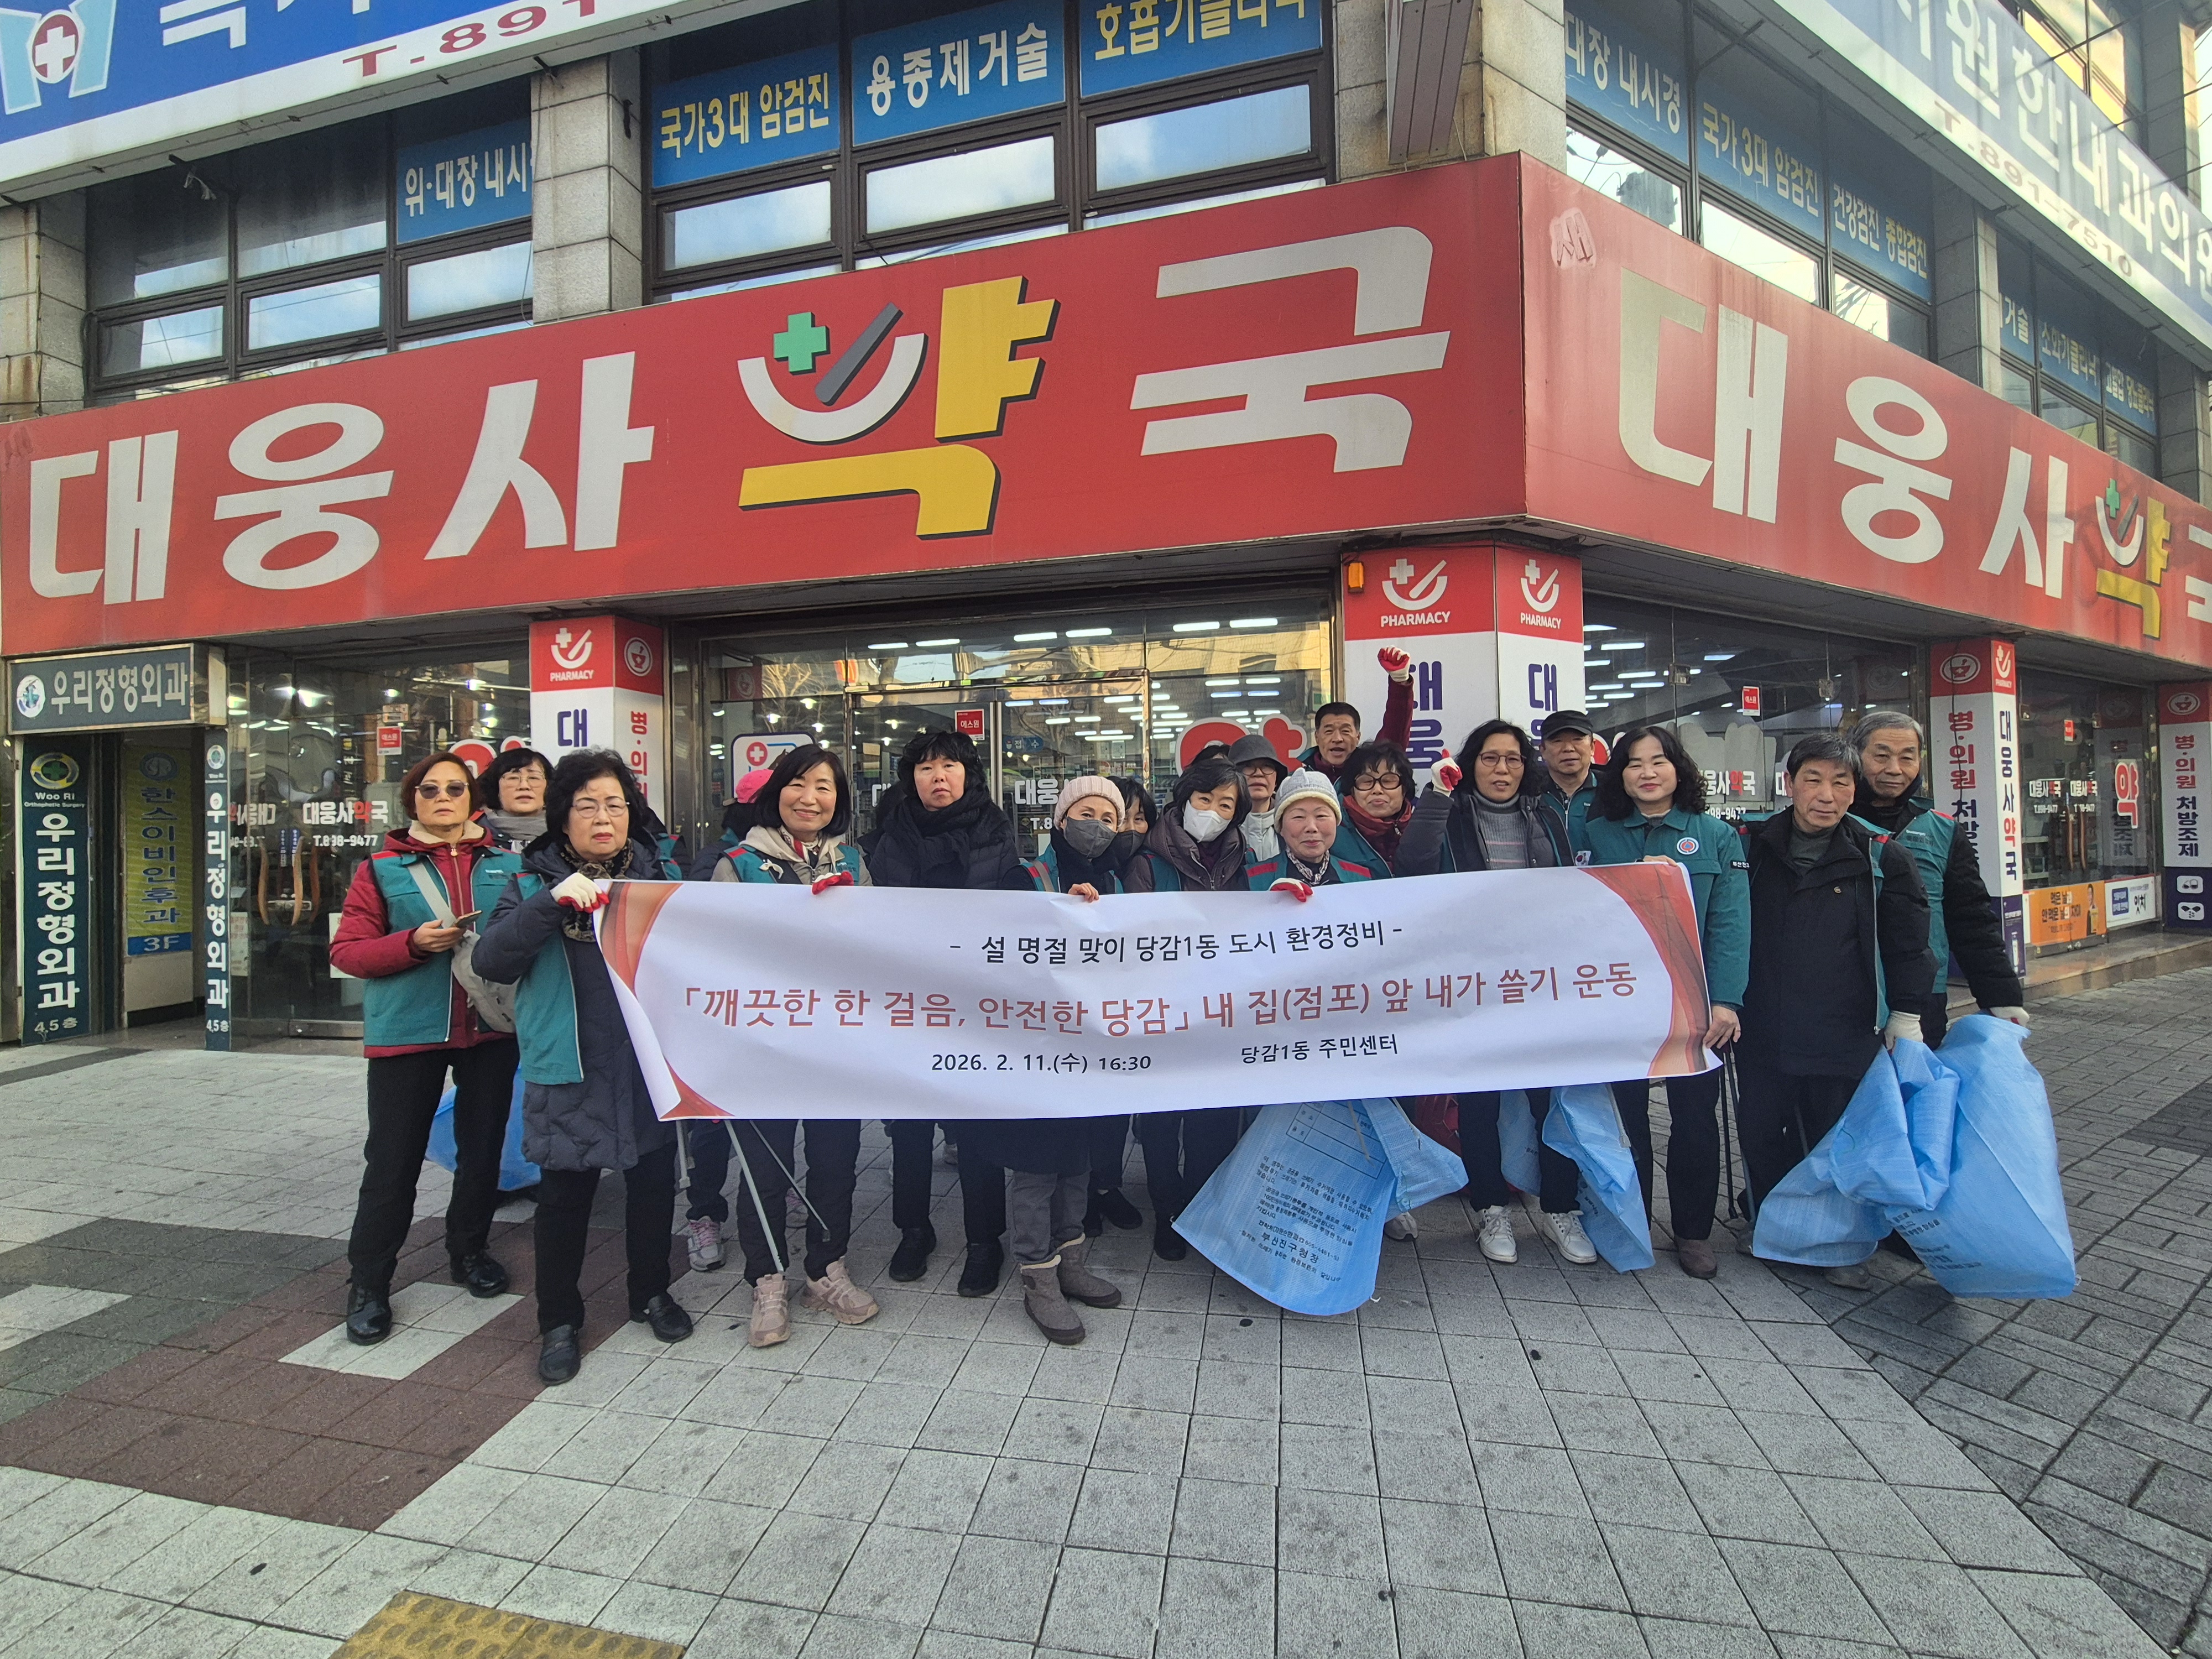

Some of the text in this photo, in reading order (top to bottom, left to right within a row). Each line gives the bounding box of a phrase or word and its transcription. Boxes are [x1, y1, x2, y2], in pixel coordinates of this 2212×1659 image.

[867, 23, 1047, 116] 용종제거술
[1564, 14, 1680, 134] 대장 내시경
[661, 72, 829, 158] 국가3대 암검진
[405, 143, 531, 217] 위·대장 내시
[1703, 102, 1818, 217] 국가3대 암검진
[1833, 183, 1927, 279] 건강검진 종합검진
[25, 226, 1452, 606] 대웅사약국
[1381, 612, 1451, 627] PHARMACY
[1520, 612, 1561, 629] PHARMACY
[51, 662, 188, 714] 우리정형외과
[550, 669, 594, 682] PHARMACY
[961, 720, 979, 728] 에스원
[1948, 711, 1976, 790] 병·의원
[303, 800, 388, 825] 대웅사약국
[1700, 769, 1756, 796] 웅사약국
[2000, 711, 2017, 881] 대웅사약국
[2115, 761, 2139, 829] 약
[2175, 735, 2199, 857] 병·의원 처방조제
[141, 787, 181, 924] 한스이비인후과
[36, 813, 80, 1009] 우리정형외과
[206, 793, 228, 1010] 우리정형외과
[143, 935, 180, 952] 3F
[980, 936, 1005, 965] 설
[1017, 936, 1067, 965] 명절
[1078, 936, 1124, 963] 맞이
[1135, 931, 1219, 963] 당감1동
[1229, 929, 1275, 956] 도시
[1286, 920, 1385, 953] 환경정비
[685, 962, 1637, 1038] 「깨끗한 한 걸음, 안전한 당감」 내 집(점포) 앞 내가 쓸기 운동
[931, 1052, 1152, 1075] 2026. 2. 11.(수) 16:30
[1240, 1033, 1399, 1065] 당감1동 주민센터
[1260, 1229, 1320, 1265] 부산진구청장
